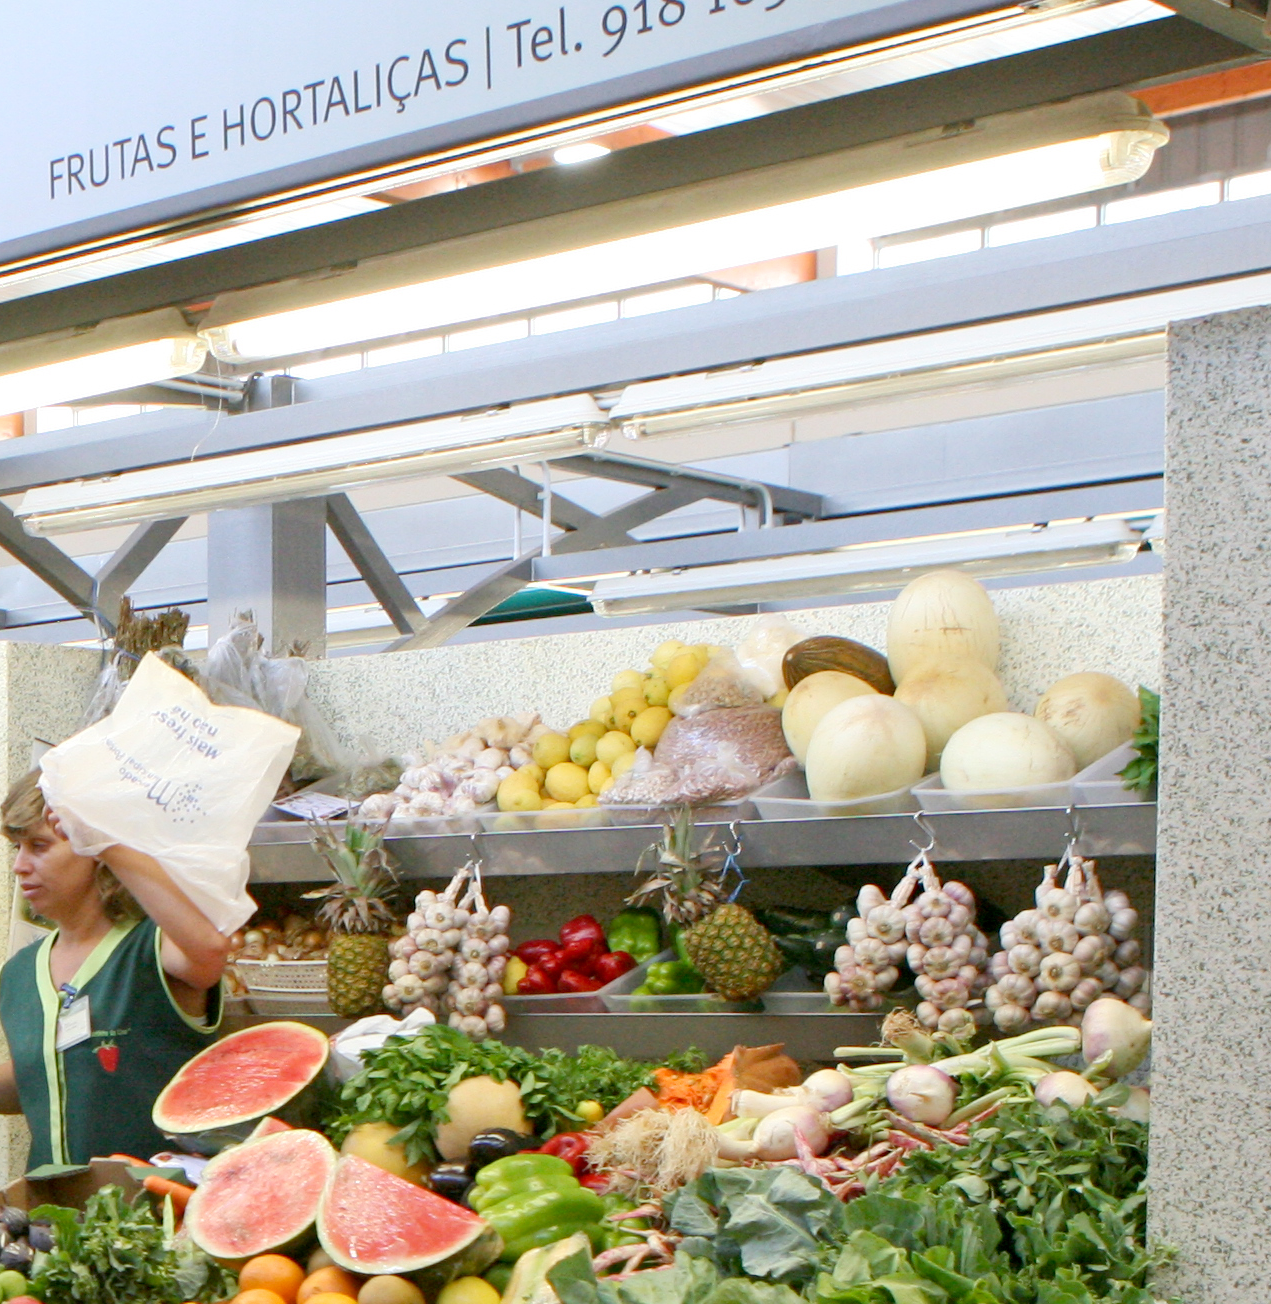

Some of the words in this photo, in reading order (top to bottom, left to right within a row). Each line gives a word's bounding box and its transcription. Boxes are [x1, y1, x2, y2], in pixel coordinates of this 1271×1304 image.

[50, 125, 177, 199] FRUTAS
[191, 114, 209, 160] E
[223, 38, 469, 151] HORTALIÇAS
[506, 6, 582, 68] Tel.
